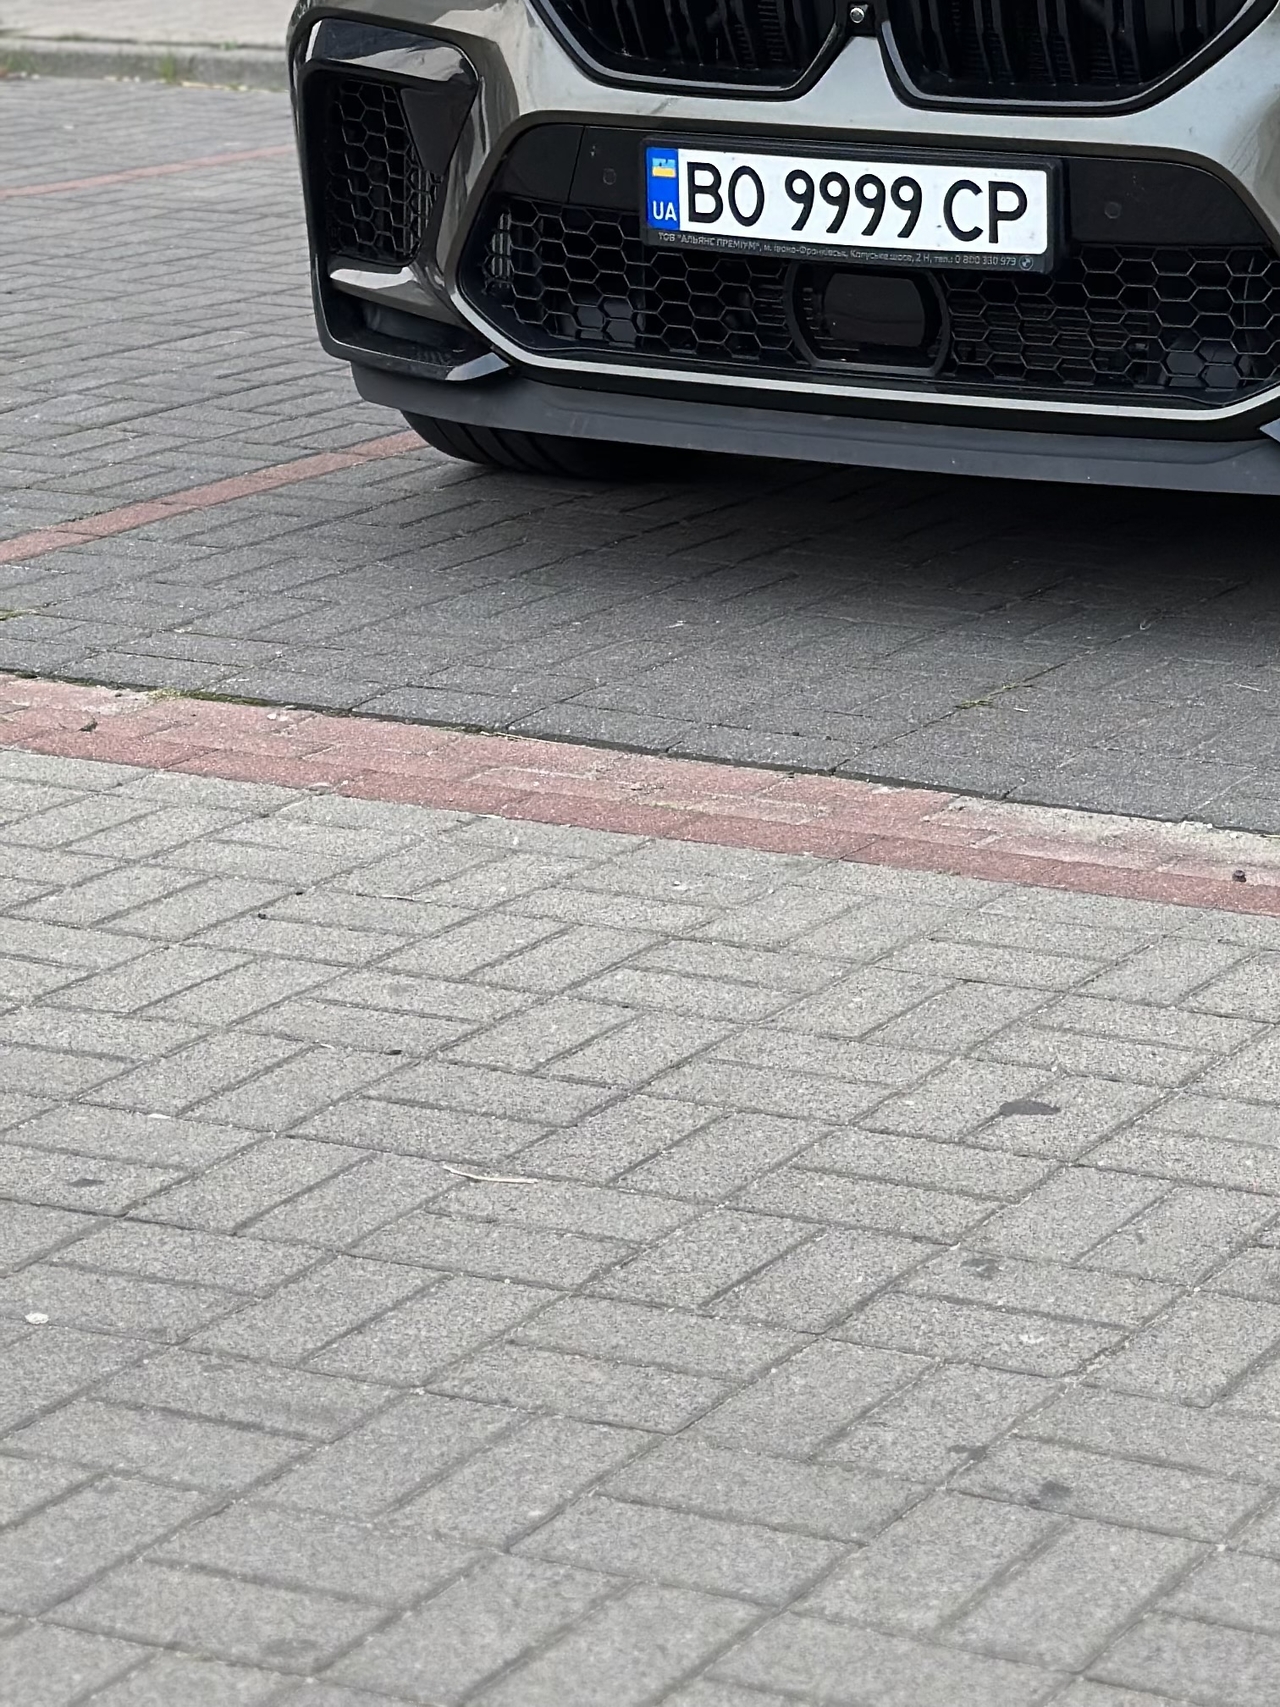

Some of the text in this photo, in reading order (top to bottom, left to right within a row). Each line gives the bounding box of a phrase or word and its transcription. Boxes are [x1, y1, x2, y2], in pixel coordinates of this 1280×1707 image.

[653, 200, 678, 222] UA
[687, 161, 1028, 244] BO 9999 CP
[659, 232, 676, 242] ТОВ
